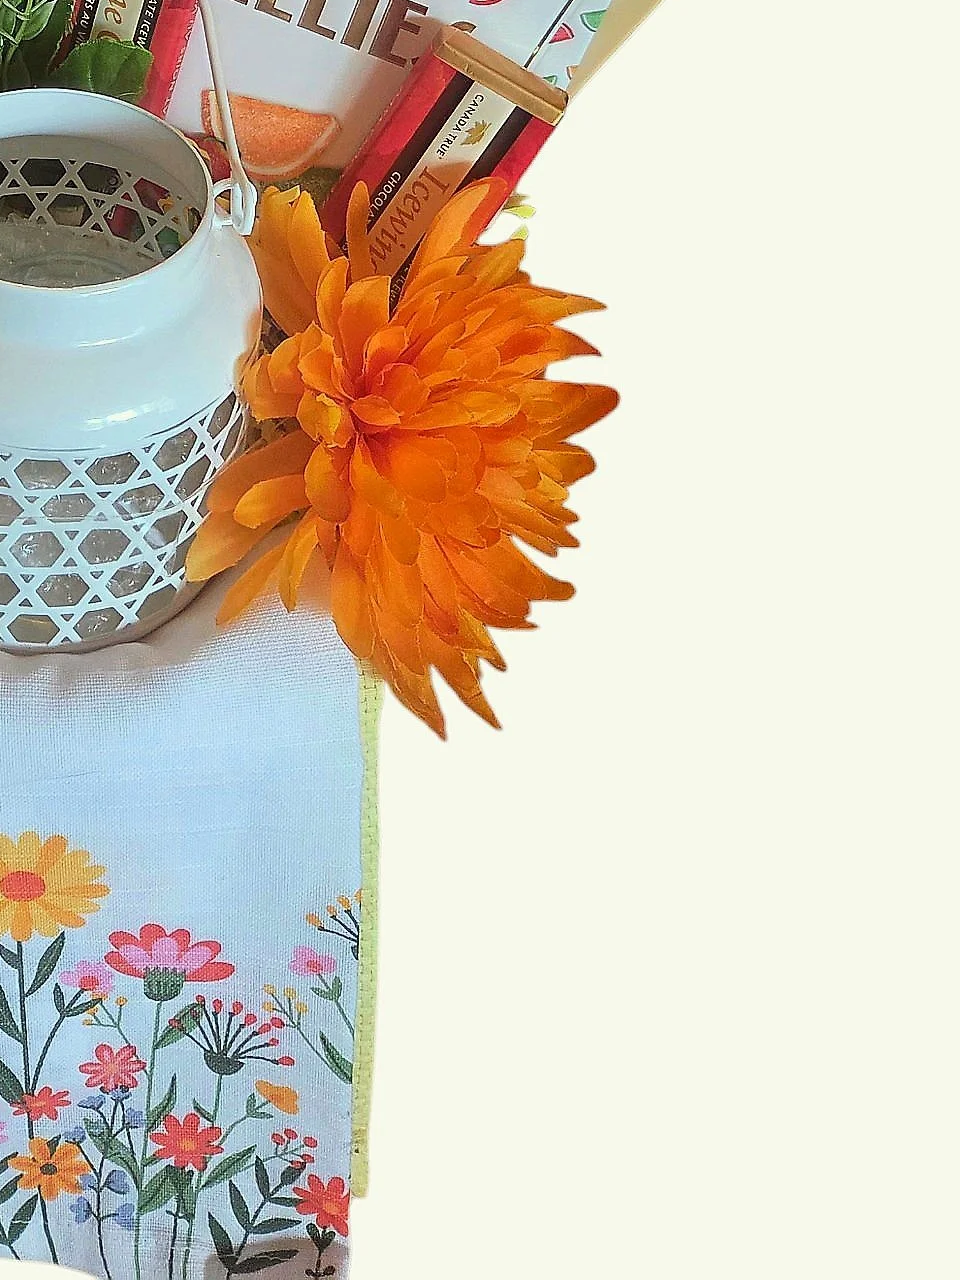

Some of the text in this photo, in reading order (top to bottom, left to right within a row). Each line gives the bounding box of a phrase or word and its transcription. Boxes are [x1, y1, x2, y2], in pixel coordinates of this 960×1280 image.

[81, 10, 90, 29] AU
[436, 94, 484, 157] CANADA TRUE
[368, 171, 402, 219] CHOCOLA
